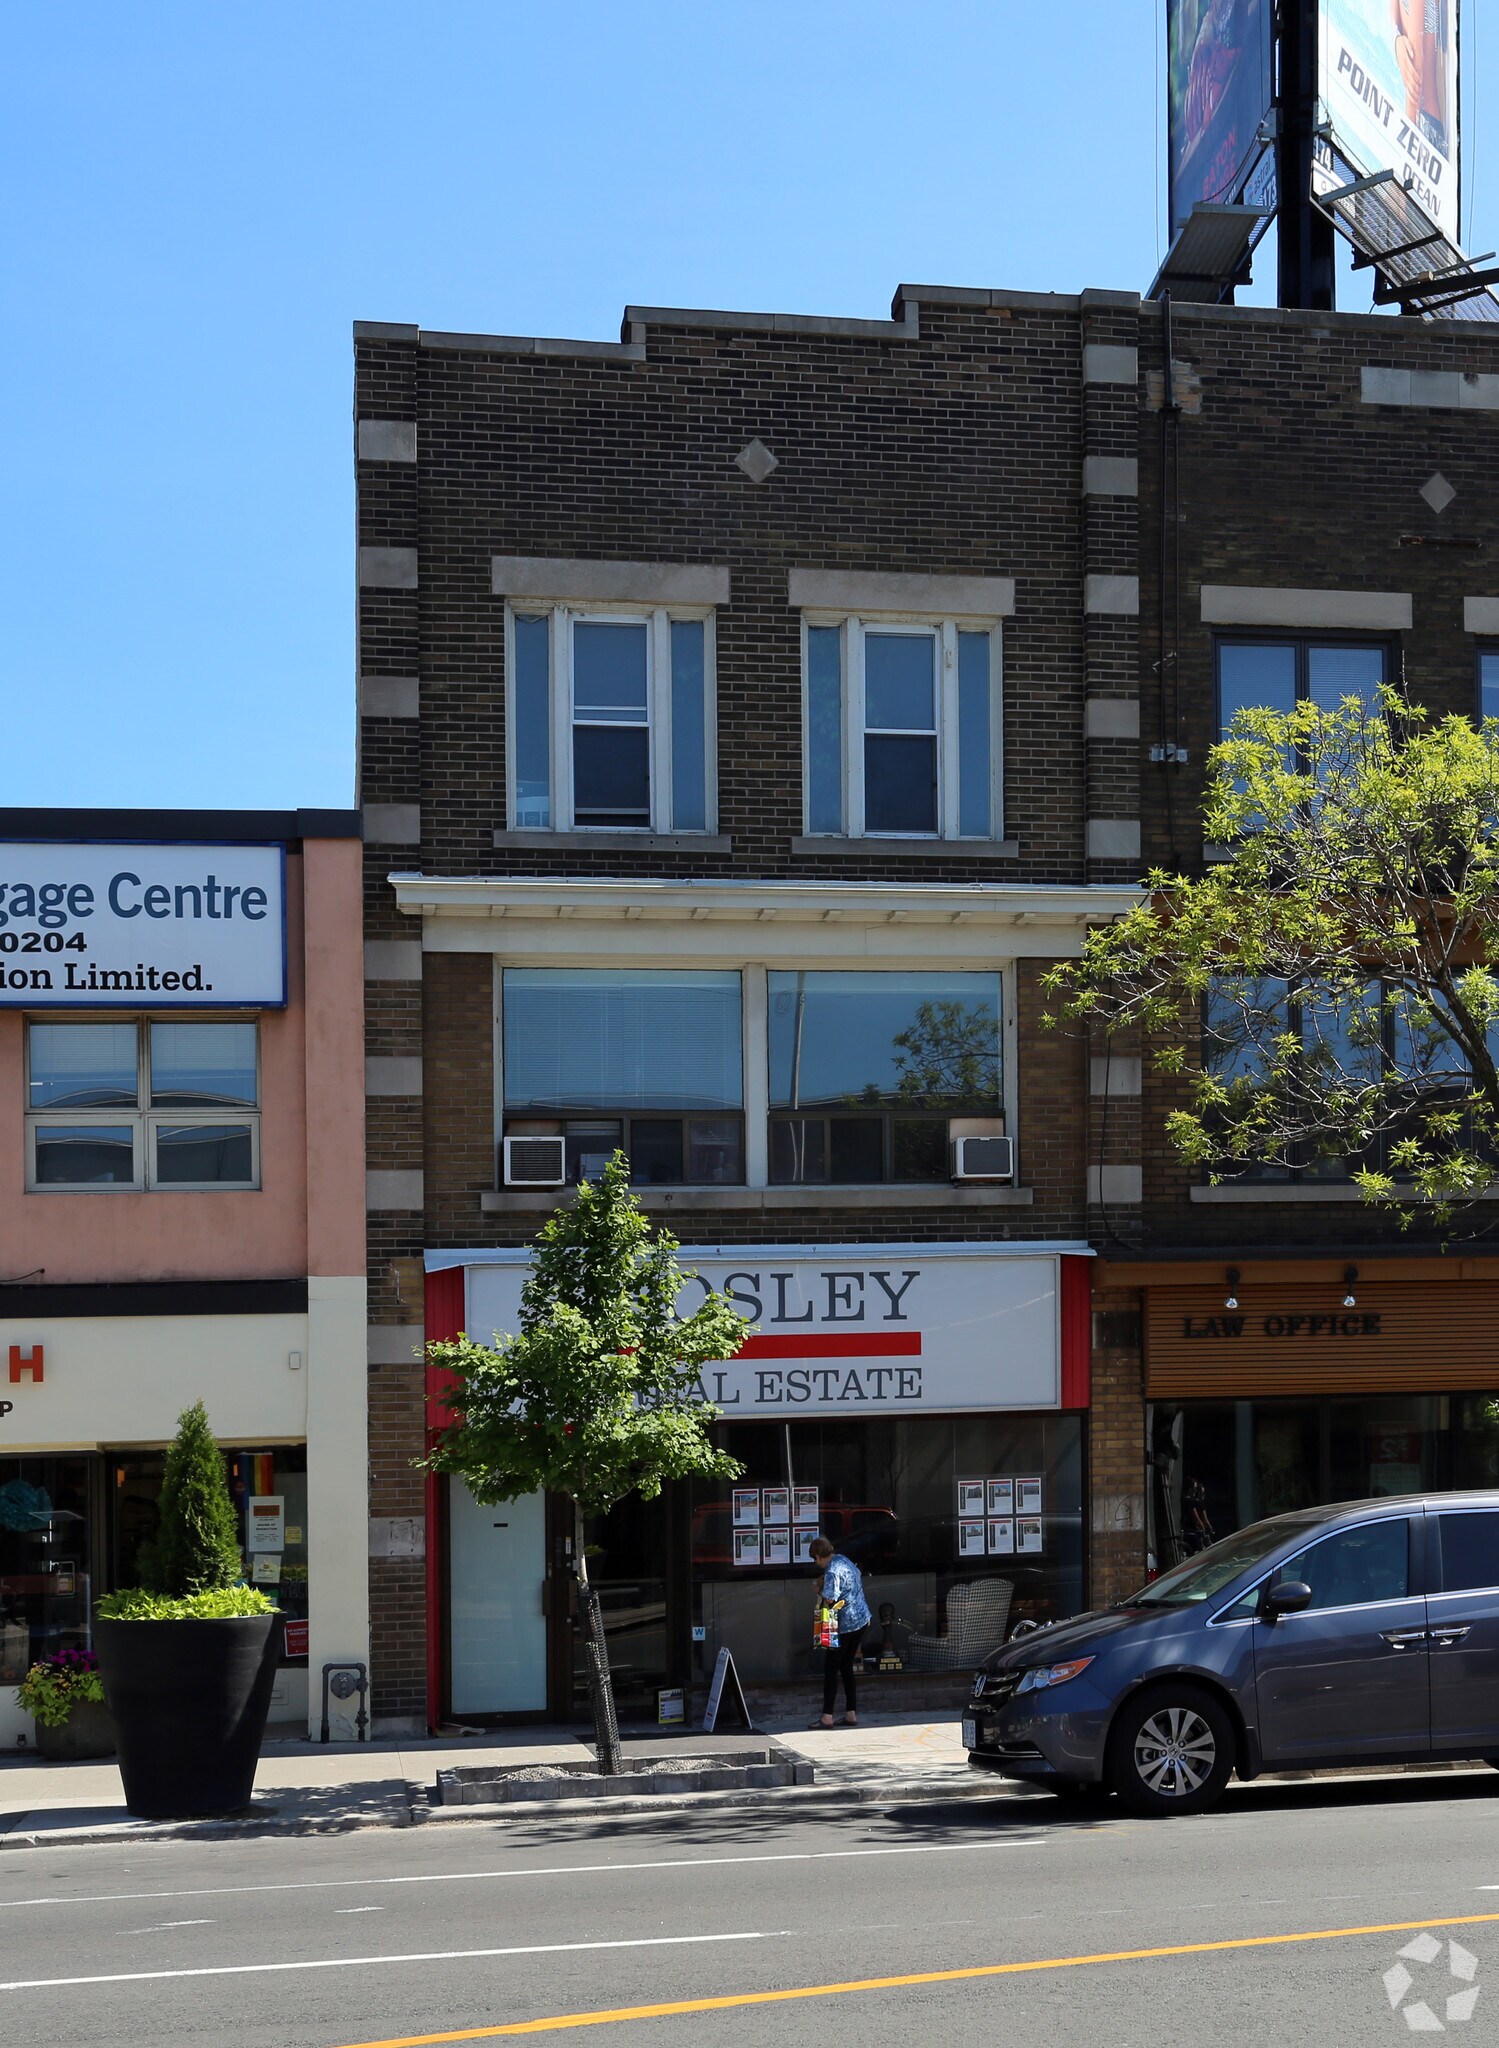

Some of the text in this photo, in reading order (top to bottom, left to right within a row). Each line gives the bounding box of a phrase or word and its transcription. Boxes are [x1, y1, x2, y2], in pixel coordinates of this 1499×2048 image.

[1337, 47, 1442, 185] POINT ZERO
[1403, 162, 1441, 217] OCEAN
[0, 872, 267, 929] age Centre
[64, 963, 212, 991] Limited.
[626, 1271, 920, 1325] OSLEY
[1183, 1312, 1381, 1338] LAW OFFICE
[9, 1345, 44, 1382] H
[755, 1367, 922, 1403] ESTATE
